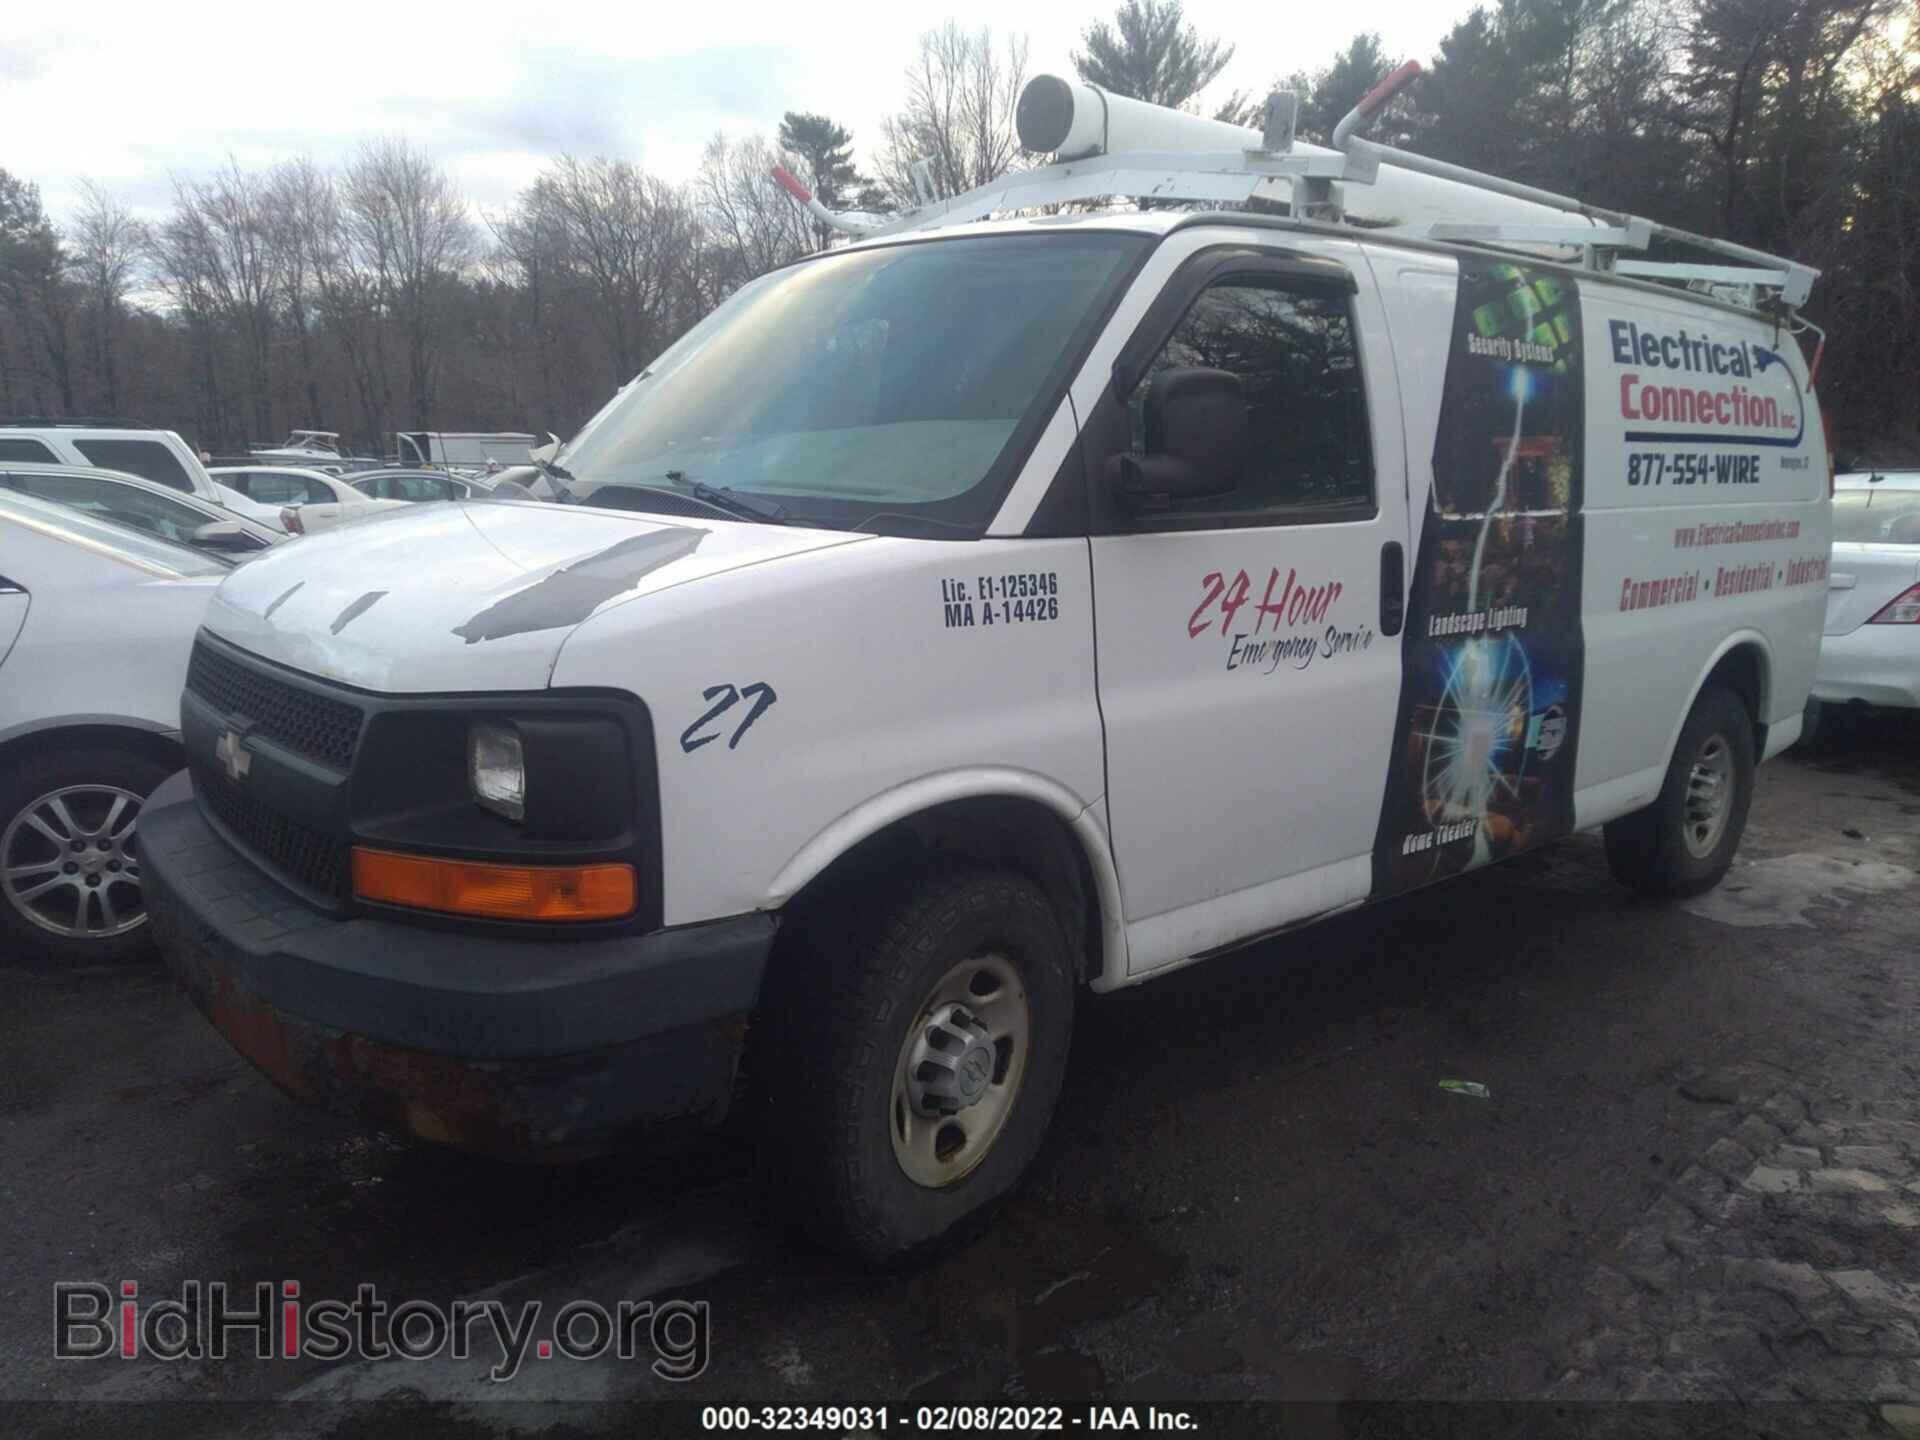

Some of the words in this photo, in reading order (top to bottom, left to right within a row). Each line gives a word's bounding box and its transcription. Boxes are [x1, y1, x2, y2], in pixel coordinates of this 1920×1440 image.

[1467, 332, 1512, 362] Security
[1514, 338, 1554, 363] Systems
[1608, 319, 1752, 378] Electrical
[1620, 374, 1777, 428] Connection
[1627, 453, 1760, 486] 877-554-WIRE
[941, 579, 972, 603] Lic.
[978, 572, 1058, 600] E1-125346
[1187, 569, 1250, 639] 24
[1253, 567, 1342, 636] Hour
[1619, 570, 1701, 612] Commercial
[1713, 561, 1776, 597] Residential
[944, 602, 975, 628] MA
[982, 597, 1059, 625] A-14426
[1429, 612, 1485, 637] Landscape
[1487, 605, 1528, 631] Lighting
[1226, 633, 1318, 675] Emegency
[680, 682, 777, 753] 27
[1402, 831, 1434, 855] Home
[1436, 819, 1474, 845] Theater
